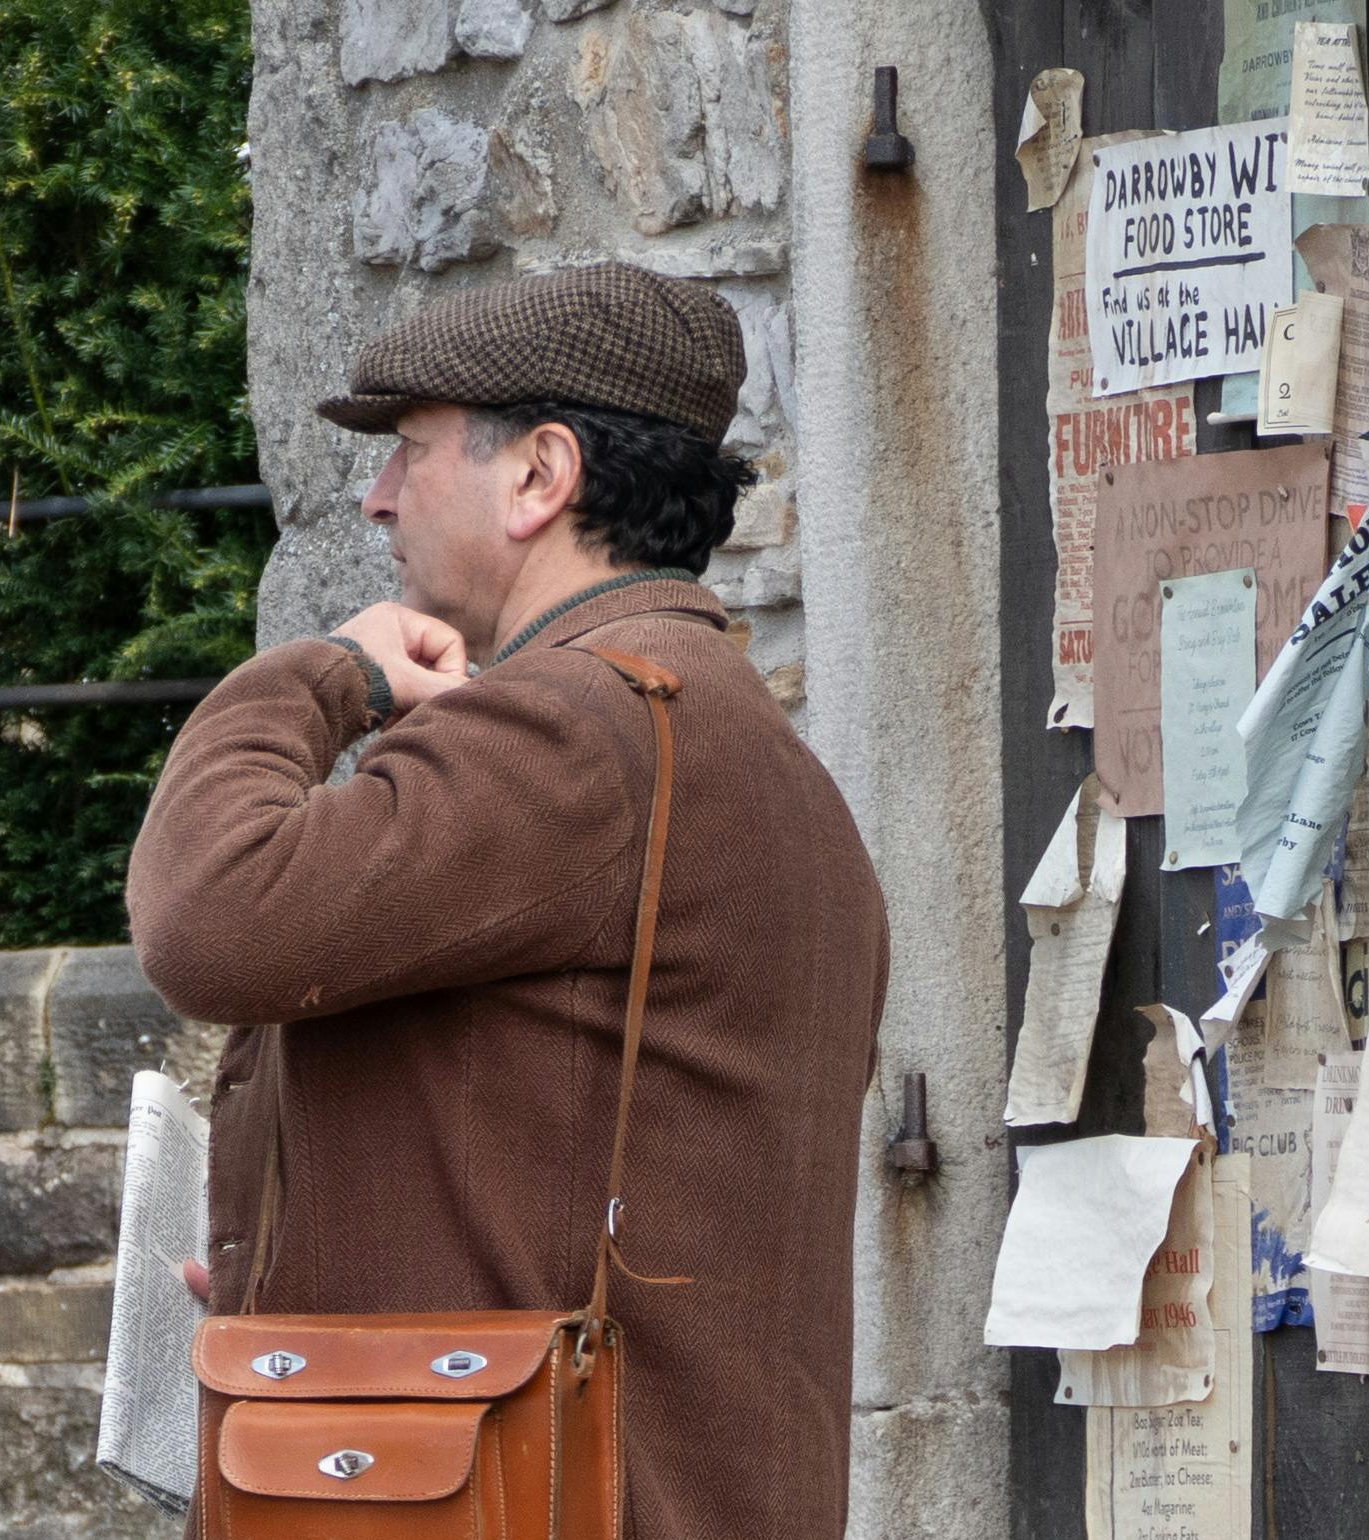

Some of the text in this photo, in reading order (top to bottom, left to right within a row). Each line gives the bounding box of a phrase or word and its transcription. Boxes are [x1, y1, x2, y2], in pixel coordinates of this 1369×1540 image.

[1105, 133, 1279, 212] DARROWBY WI
[1124, 212, 1176, 259] FOOD
[1183, 203, 1253, 249] STORE
[1102, 279, 1200, 318] Find us at the
[1112, 310, 1209, 367] VILLAGE
[1130, 491, 1251, 542] NON-STOP
[1257, 484, 1323, 527] DRIVE
[1143, 547, 1174, 581] TO
[1180, 537, 1267, 578] PROVIDE
[1290, 812, 1323, 832] Lane
[1258, 1131, 1297, 1157] CLUB
[1164, 1248, 1200, 1274] Hall
[1164, 1302, 1197, 1329] 1946
[1170, 1438, 1180, 1457] of
